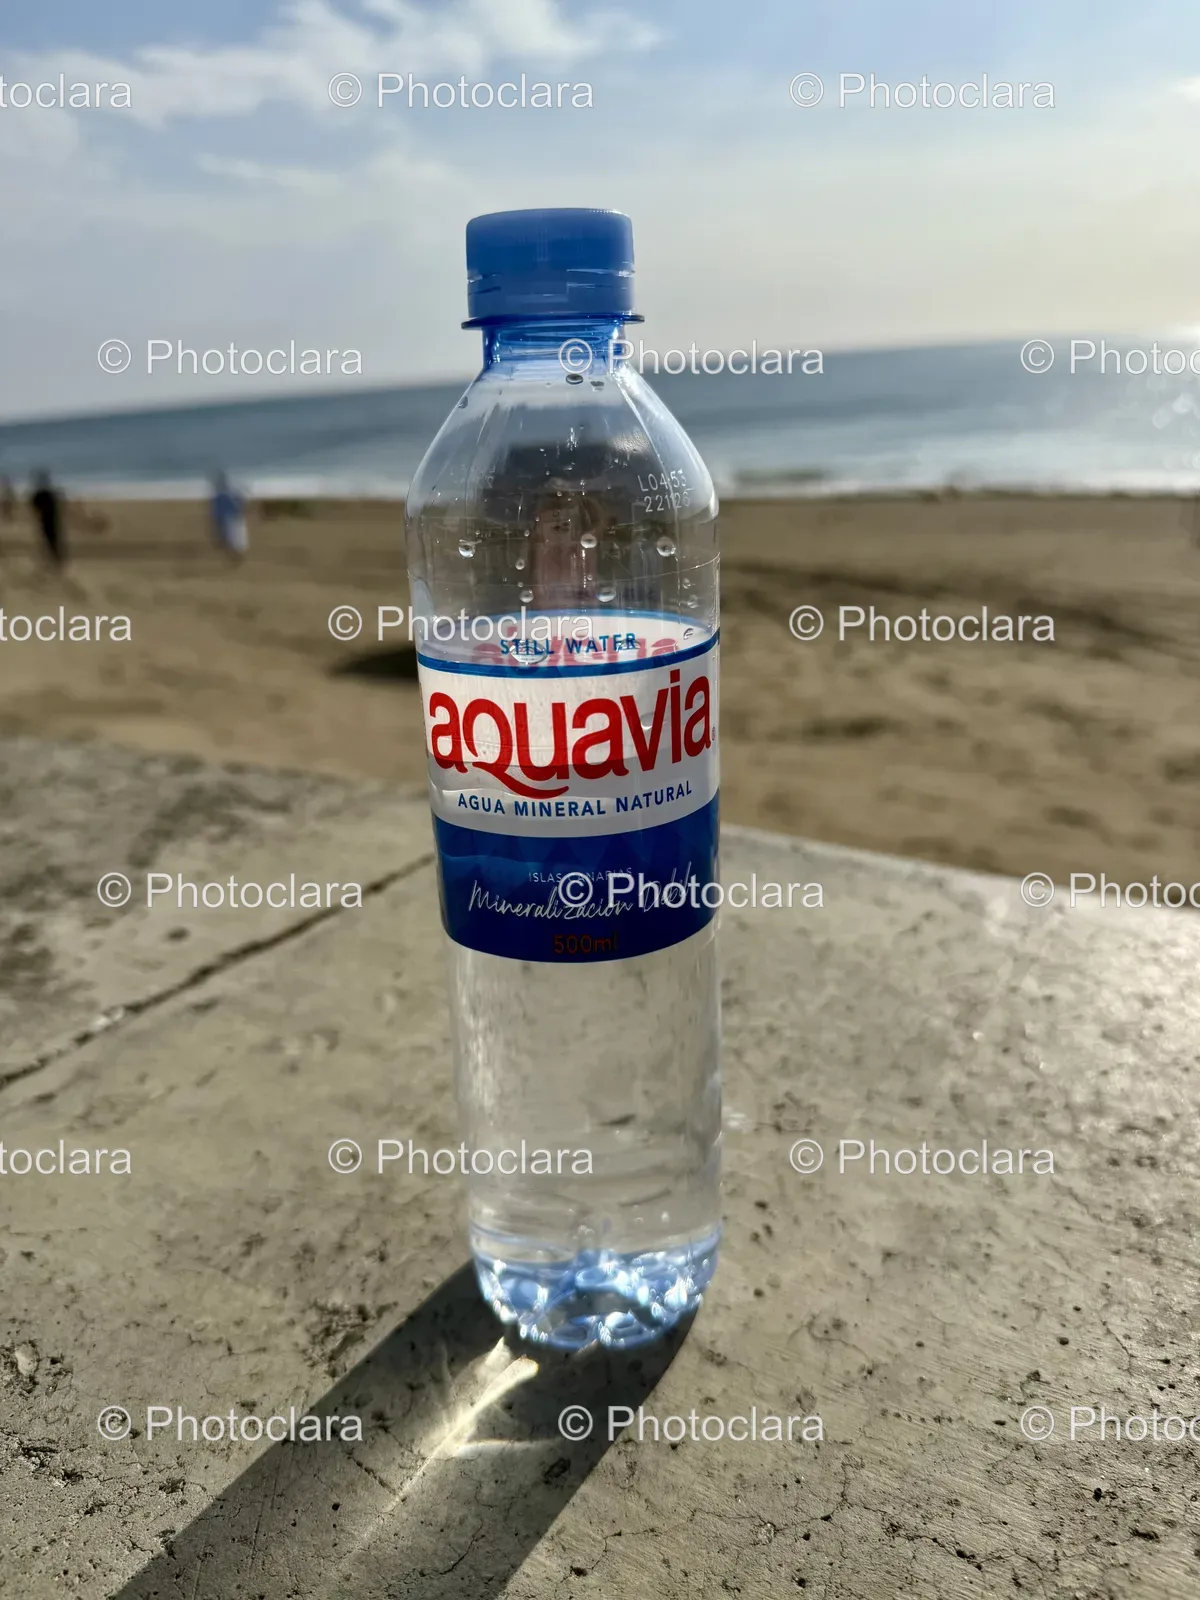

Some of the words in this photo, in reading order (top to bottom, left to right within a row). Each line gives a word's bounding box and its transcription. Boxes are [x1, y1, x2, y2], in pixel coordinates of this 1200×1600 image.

[500, 637, 555, 655] STILL
[565, 632, 637, 653] WATER
[457, 793, 506, 815] AGUA
[514, 799, 607, 818] MINERAL
[615, 780, 693, 813] NATURAL
[528, 871, 562, 884] ISLAS
[563, 866, 633, 884] ANARIAS
[553, 930, 619, 954] 500ml
